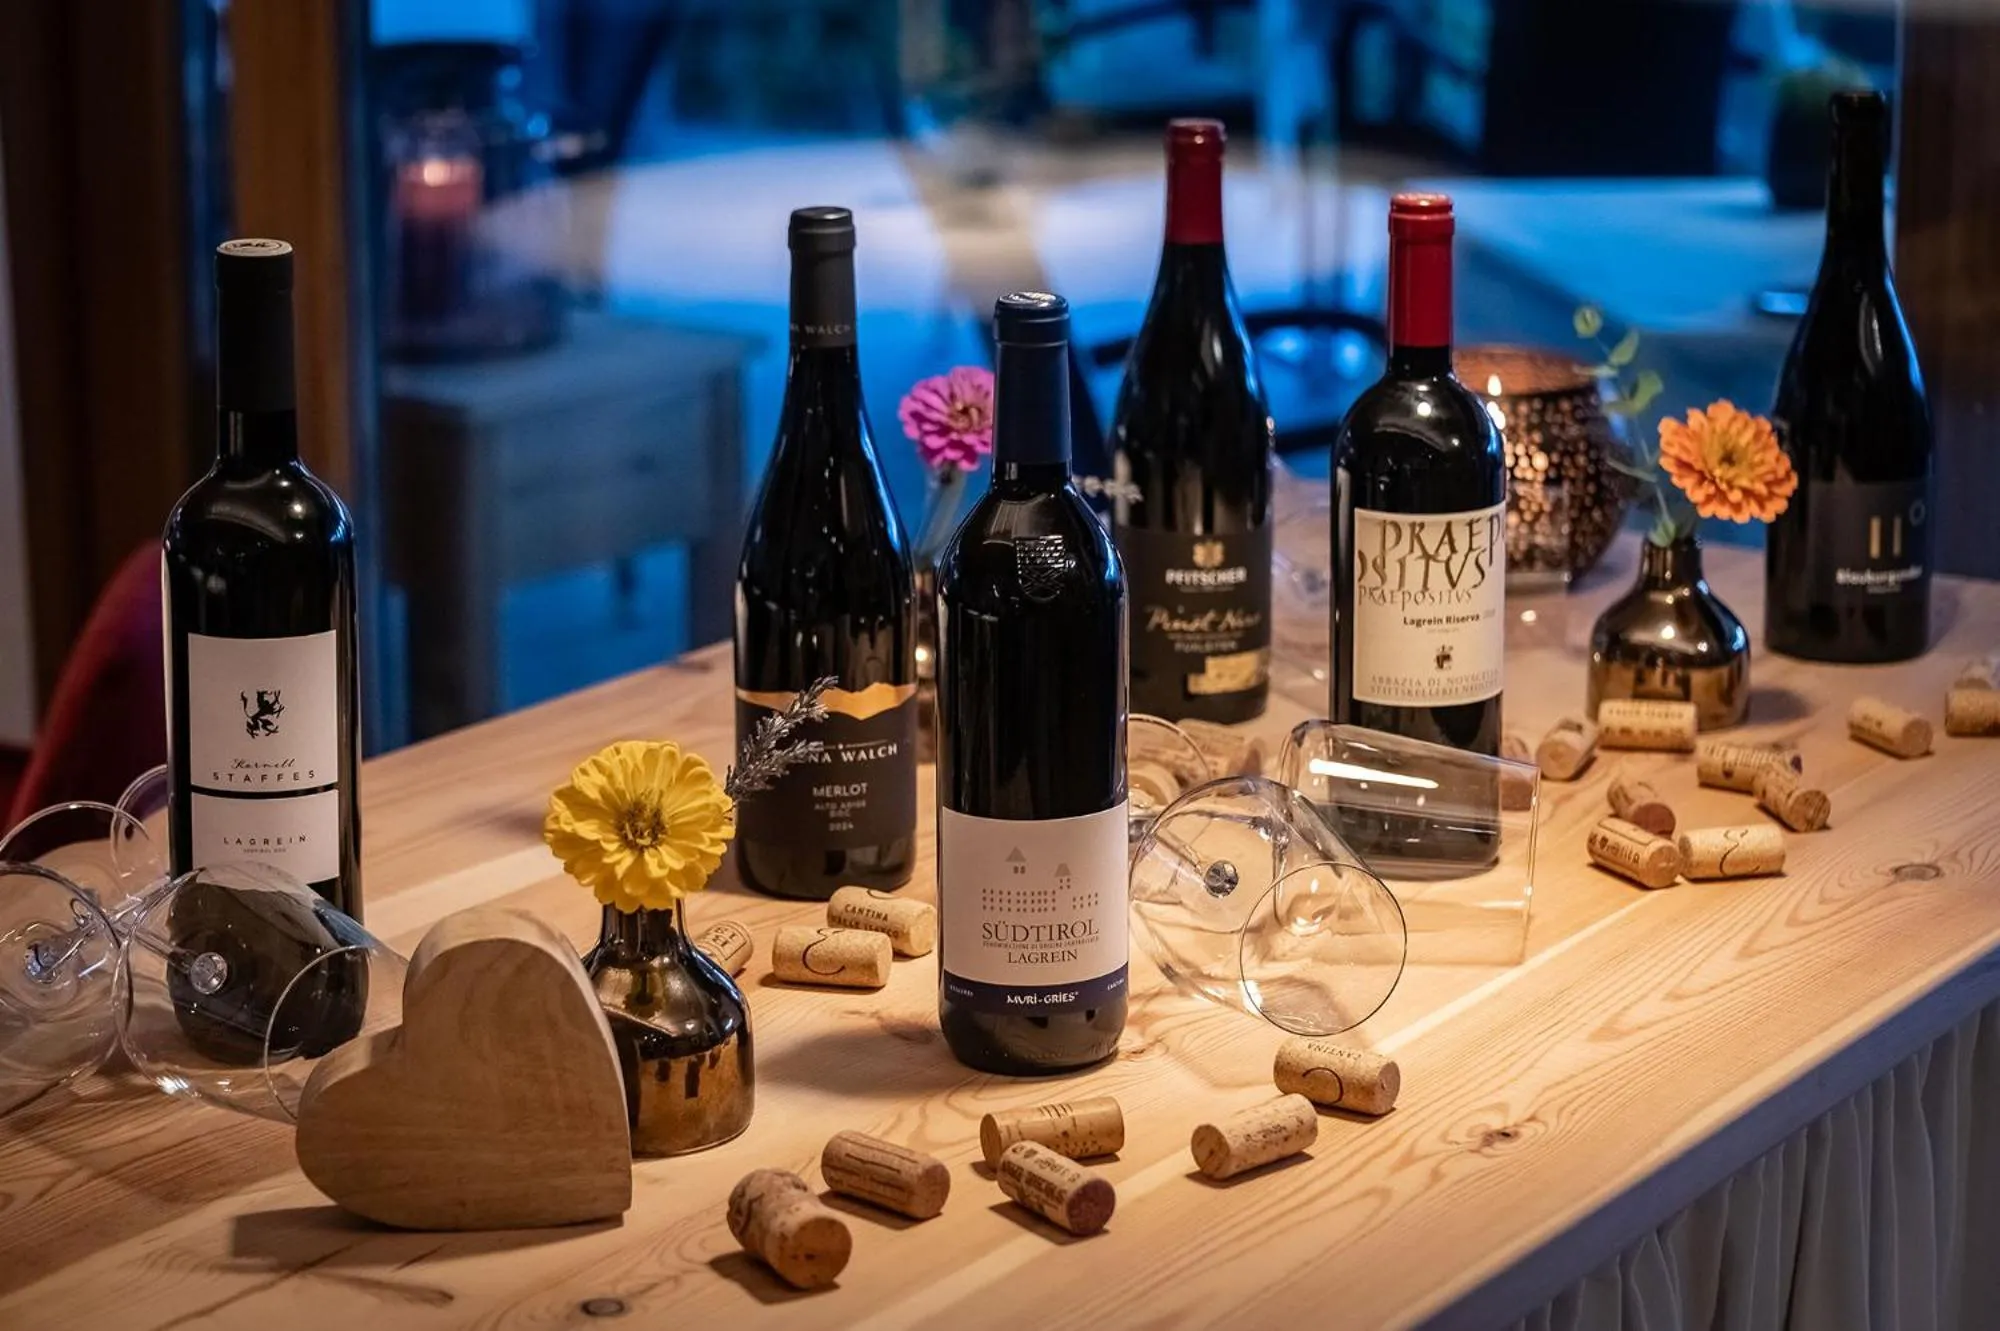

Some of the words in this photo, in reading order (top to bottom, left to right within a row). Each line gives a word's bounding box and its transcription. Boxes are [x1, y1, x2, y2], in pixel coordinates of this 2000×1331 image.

[1375, 513, 1505, 567] PRAEP
[1403, 616, 1443, 628] Lagrein
[1445, 613, 1480, 625] Riserva
[841, 743, 898, 762] WALCH
[213, 770, 315, 783] STAFFES
[812, 782, 868, 798] MERLOT
[223, 834, 306, 846] LAGREIN
[844, 903, 888, 921] CANTINA
[982, 919, 1099, 942] SÜDTIROL
[1008, 949, 1078, 964] LAGREIN
